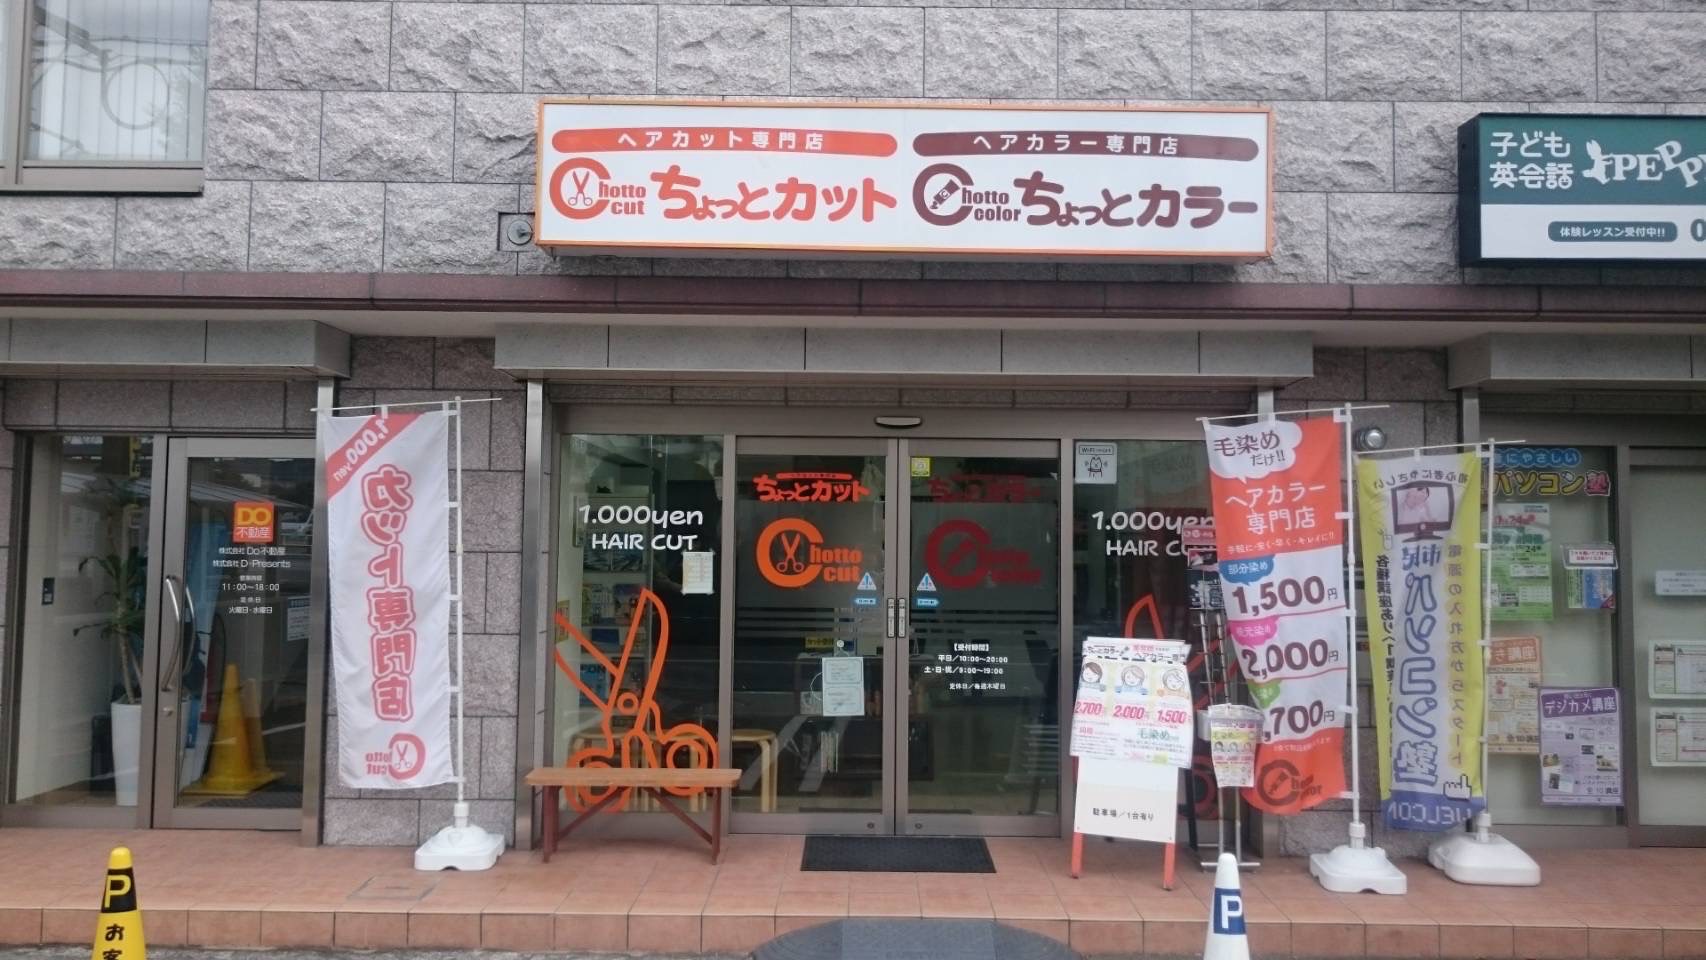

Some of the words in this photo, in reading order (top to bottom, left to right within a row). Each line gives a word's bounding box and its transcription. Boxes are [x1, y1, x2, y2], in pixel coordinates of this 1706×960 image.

[618, 130, 824, 151] ヘアカット専門店
[973, 134, 1179, 156] ヘアカラー専門店
[1490, 130, 1571, 158] 子ども
[1489, 162, 1573, 189] 英会話
[650, 165, 897, 222] ちょっとカット
[1013, 170, 1258, 229] ちょっとカラー
[611, 199, 645, 216] cut
[974, 205, 1021, 222] color
[1560, 226, 1666, 238] 体験レッスン受付中!!
[1214, 430, 1280, 457] 毛染め
[1495, 451, 1578, 463] にやさしい
[753, 474, 872, 502] ちょっとカット
[1225, 482, 1326, 509] ヘアカラー
[237, 507, 272, 526] DO
[579, 505, 704, 528] 1.000yen
[1246, 506, 1316, 535] 専門店
[235, 527, 271, 538] 不動産
[591, 533, 644, 550] HAIR
[651, 534, 698, 551] CUT
[1106, 540, 1159, 556] HAIR
[1544, 696, 1617, 714] デジカメ講座
[104, 874, 132, 909] P
[1221, 895, 1243, 929] P
